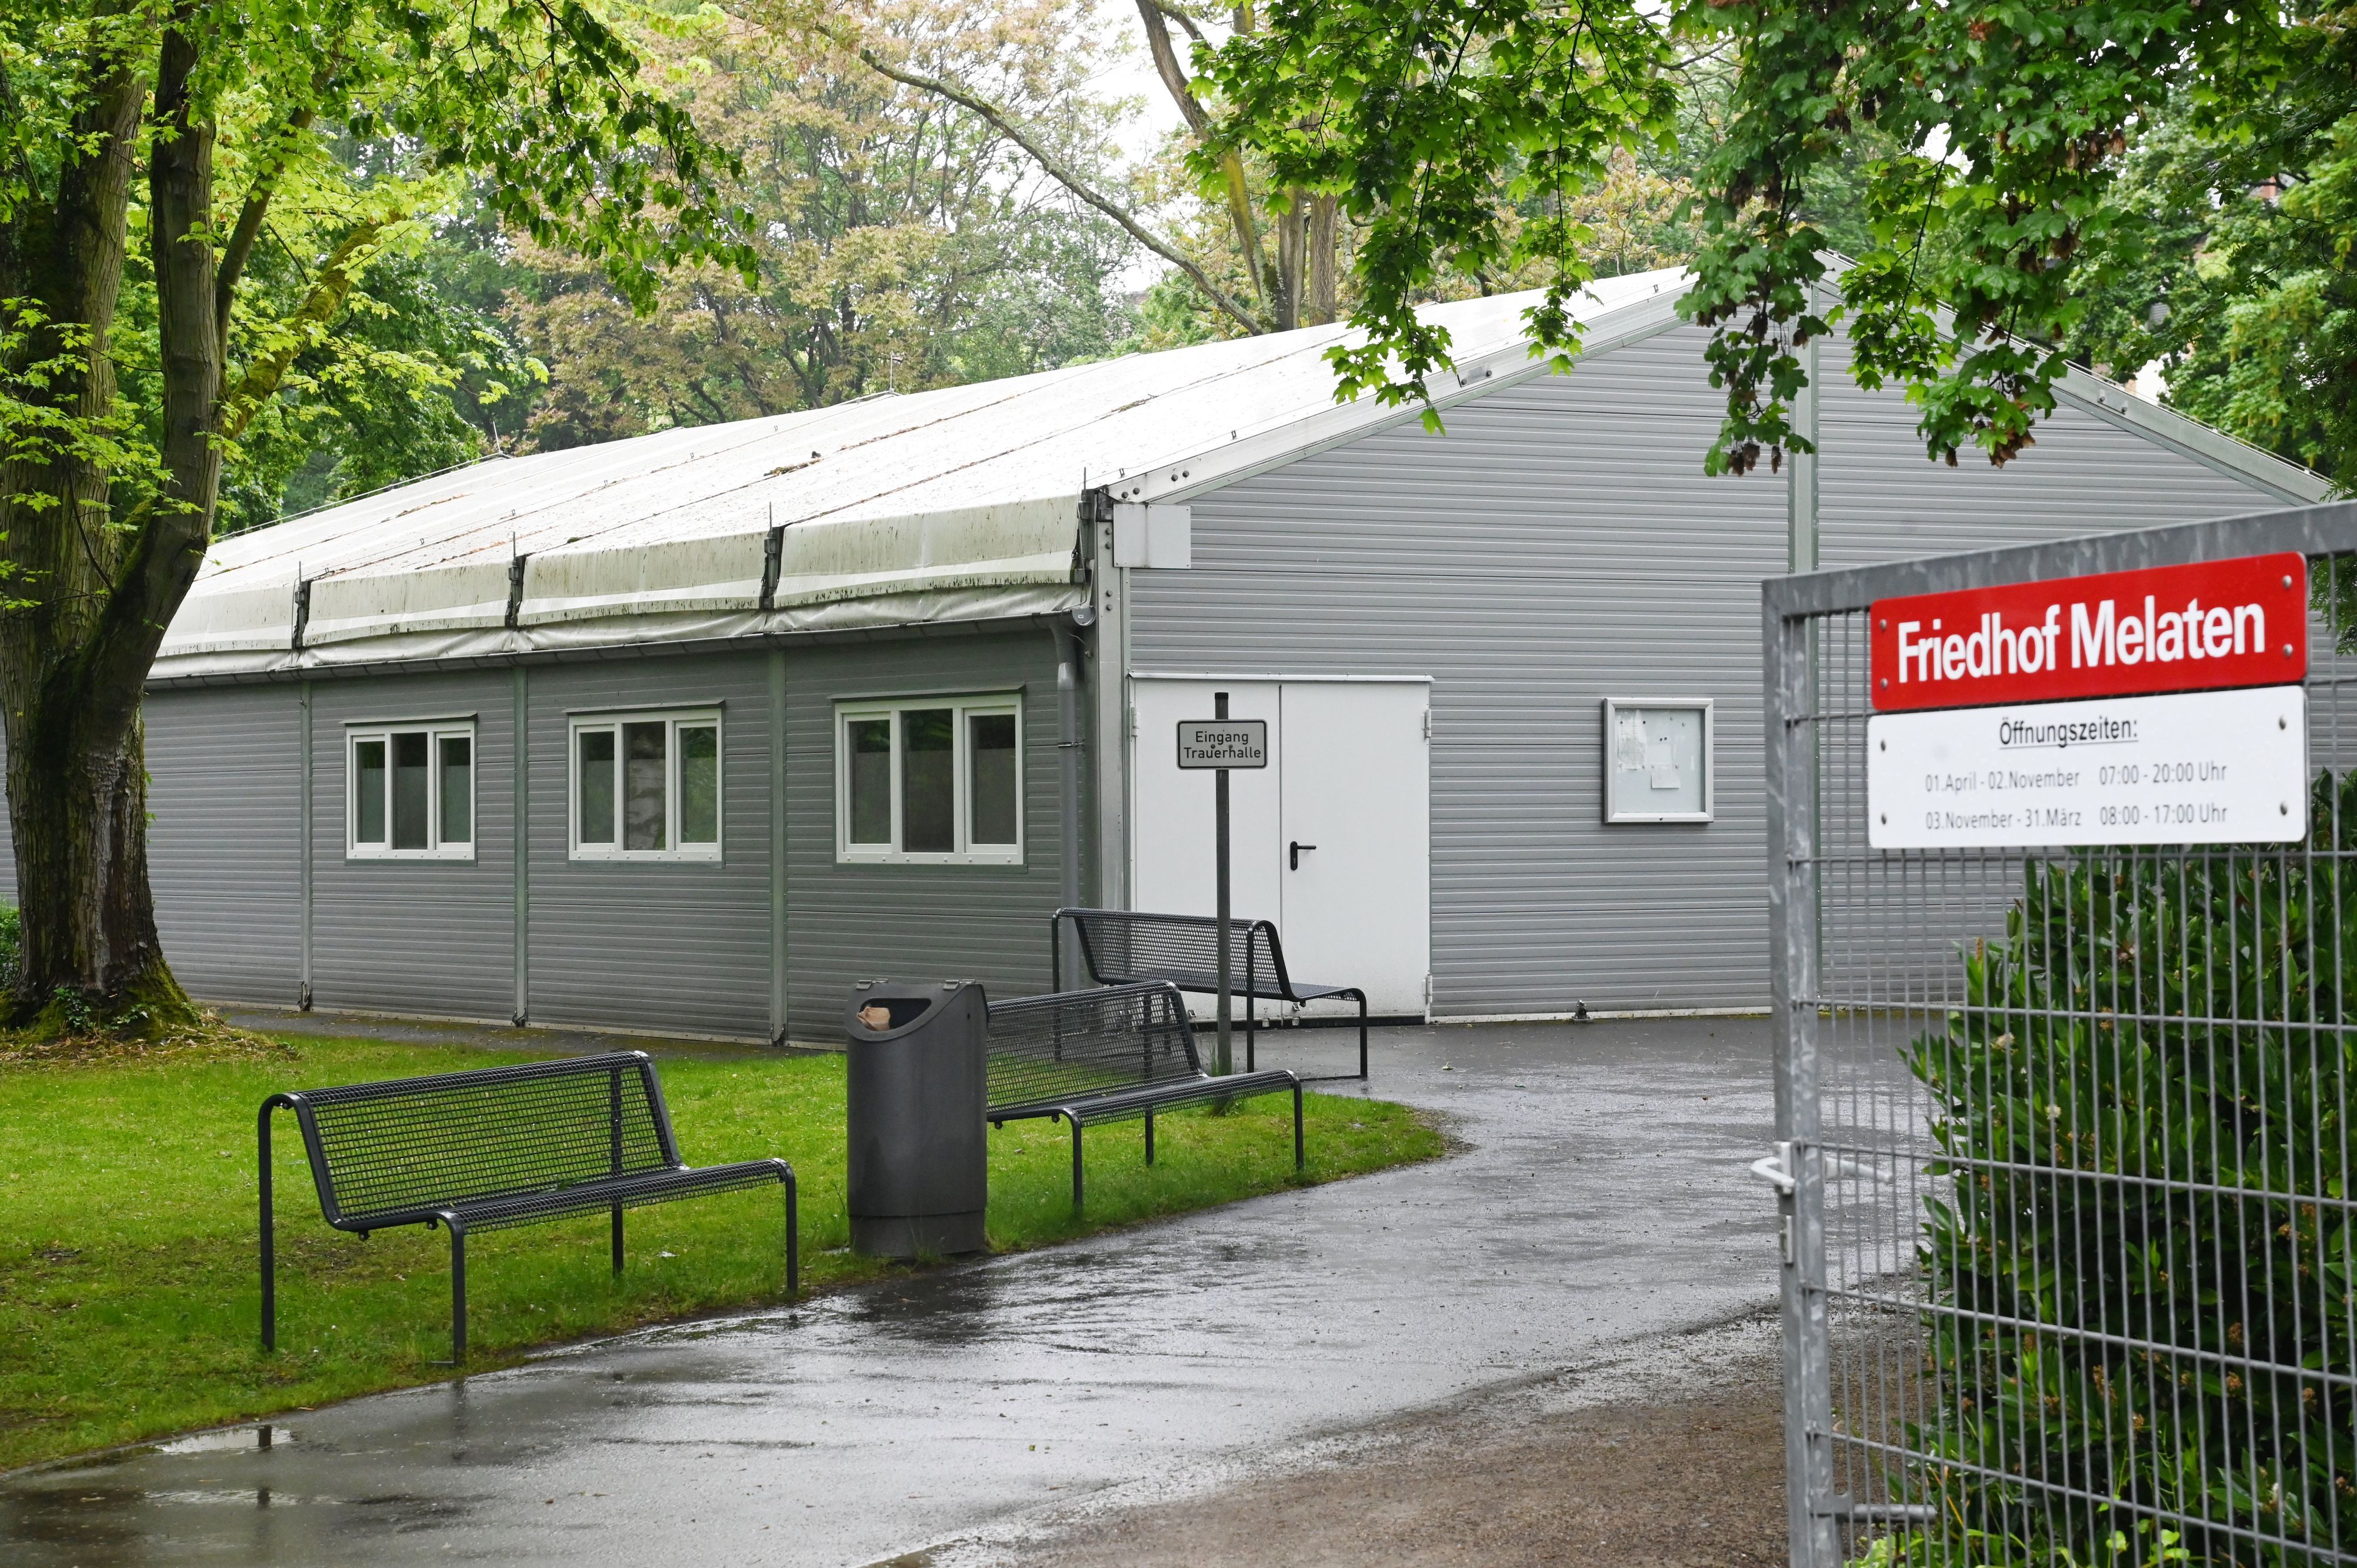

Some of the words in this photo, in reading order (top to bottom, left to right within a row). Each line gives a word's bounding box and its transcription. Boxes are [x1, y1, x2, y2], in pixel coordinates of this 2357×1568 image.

[1898, 604, 2061, 684] Friedhof
[2071, 595, 2265, 668] Melaten
[1196, 730, 1249, 745] Eingang
[2000, 716, 2138, 748] Öffnungszeiten:
[1183, 746, 1261, 759] Trauerhalle
[1925, 771, 1976, 794] 01.April
[1988, 767, 2080, 790] 02.November
[2099, 765, 2139, 785] 07:00
[2153, 762, 2193, 783] 20:00
[2199, 761, 2227, 782] Uhr
[1926, 808, 2012, 829] 03.November
[2025, 808, 2081, 827] 31.März
[2100, 805, 2139, 826] 08:00
[2154, 803, 2194, 824] 17:00
[2200, 802, 2227, 823] Uhr
